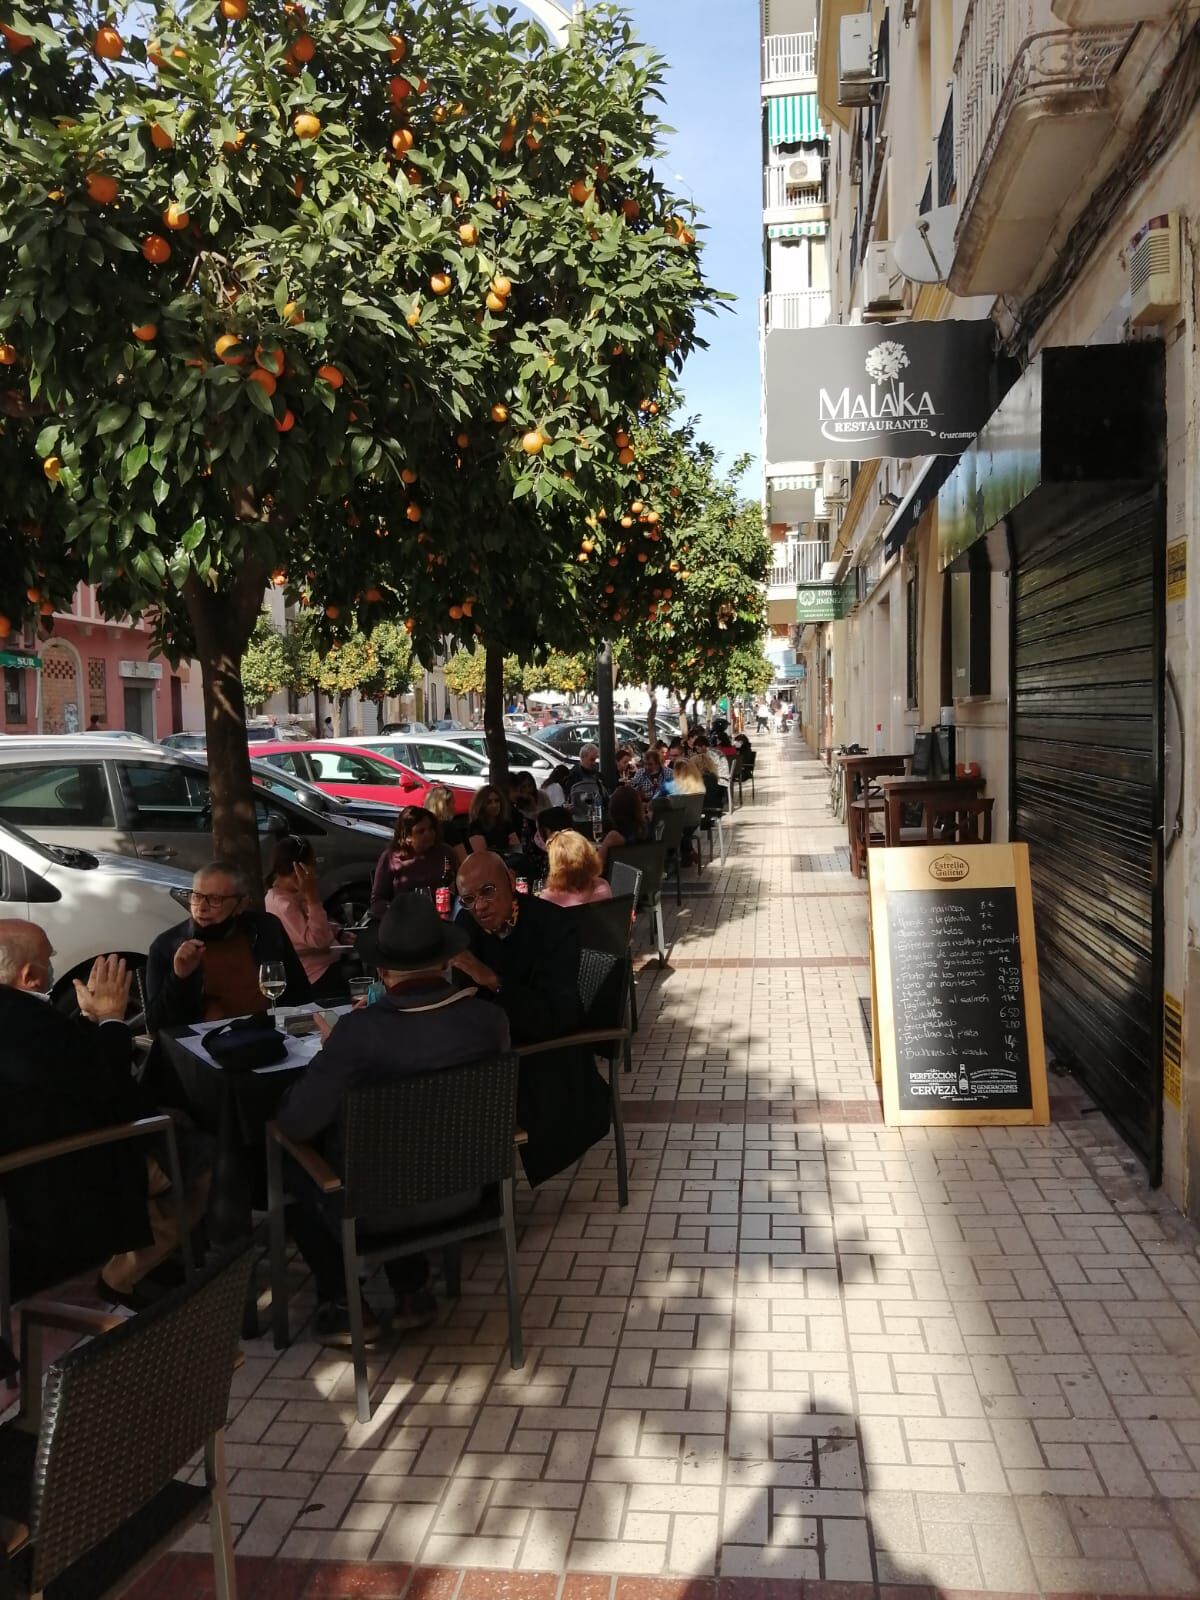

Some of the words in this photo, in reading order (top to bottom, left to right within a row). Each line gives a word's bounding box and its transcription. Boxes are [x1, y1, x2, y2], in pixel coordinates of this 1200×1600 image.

[835, 418, 929, 433] RESTAURANTE
[939, 431, 978, 440] Cruzcampo
[17, 657, 35, 666] SUR
[935, 861, 964, 869] Estrella
[936, 869, 964, 877] Galicia
[909, 1071, 957, 1080] PERFECCIÓN
[910, 1086, 959, 1095] CERVEZA
[970, 1085, 978, 1094] 5
